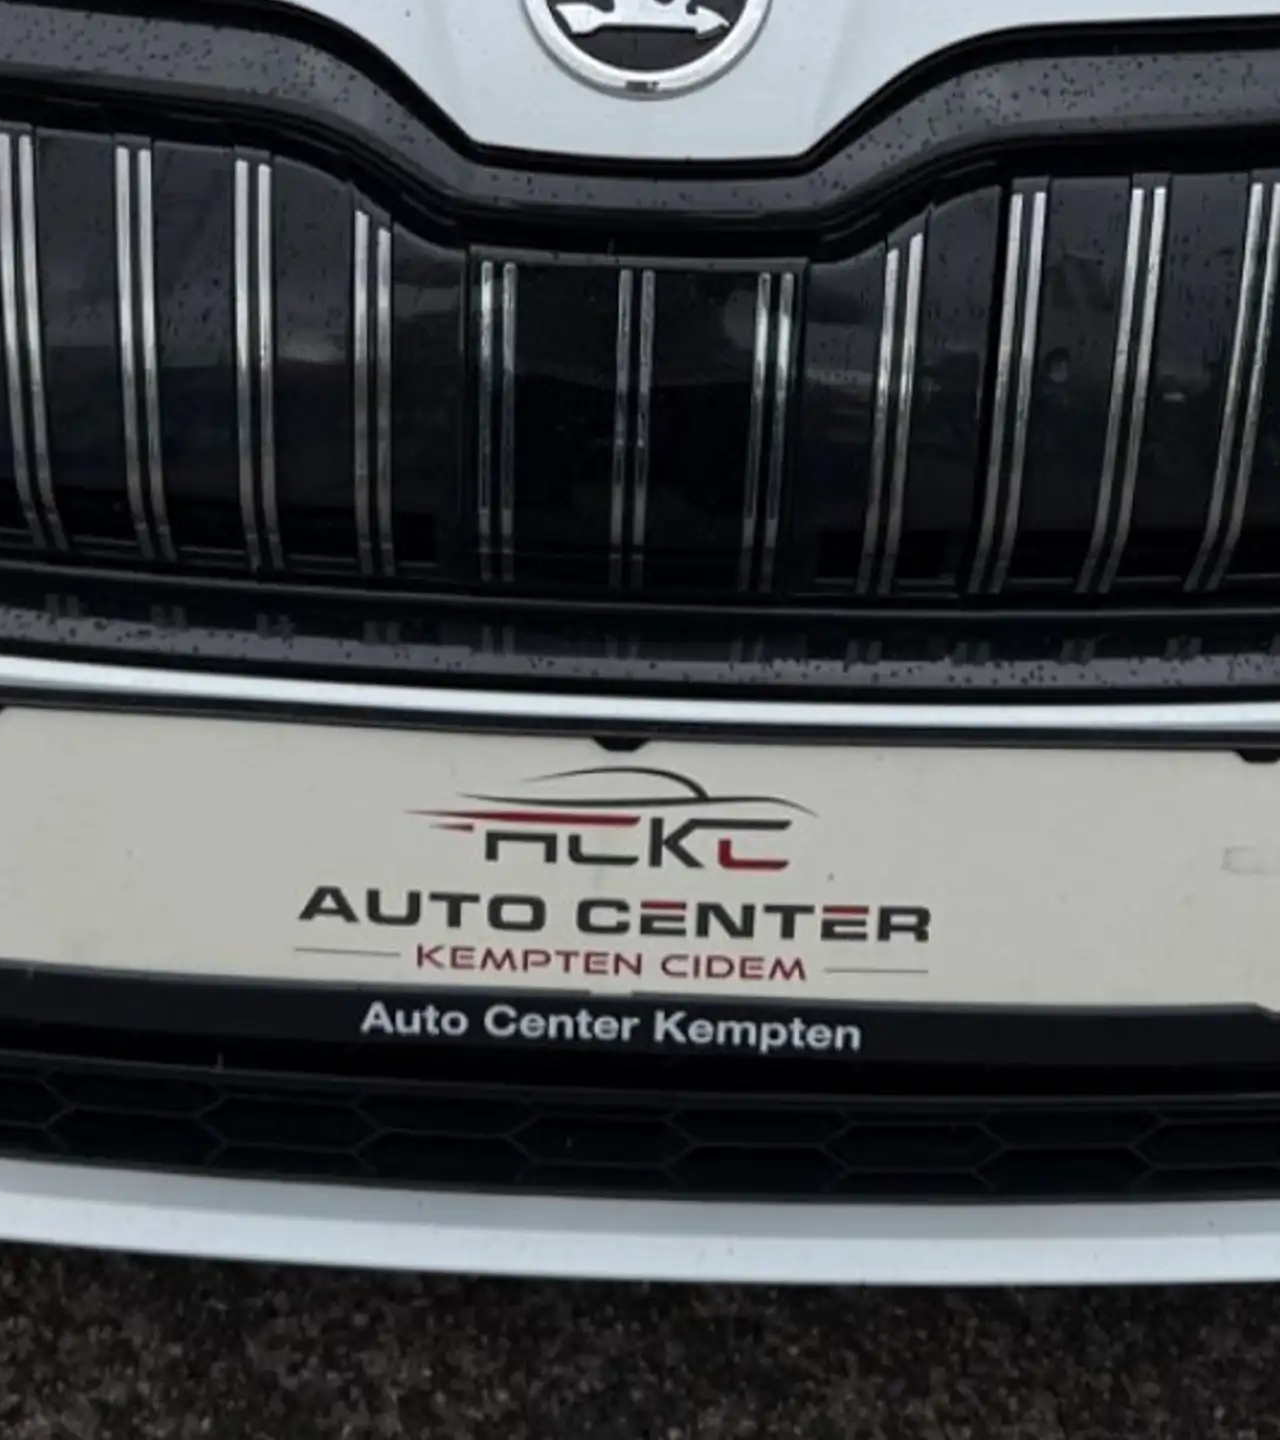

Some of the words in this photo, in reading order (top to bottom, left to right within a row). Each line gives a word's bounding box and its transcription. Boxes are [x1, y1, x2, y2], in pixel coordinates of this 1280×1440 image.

[297, 884, 548, 935] AUTO
[575, 898, 933, 943] CENTER
[416, 943, 643, 978] KEMPTEN
[660, 954, 807, 982] CIDEM
[360, 1000, 469, 1039] Auto
[483, 1004, 640, 1042] Center
[652, 1010, 863, 1054] Kempten
